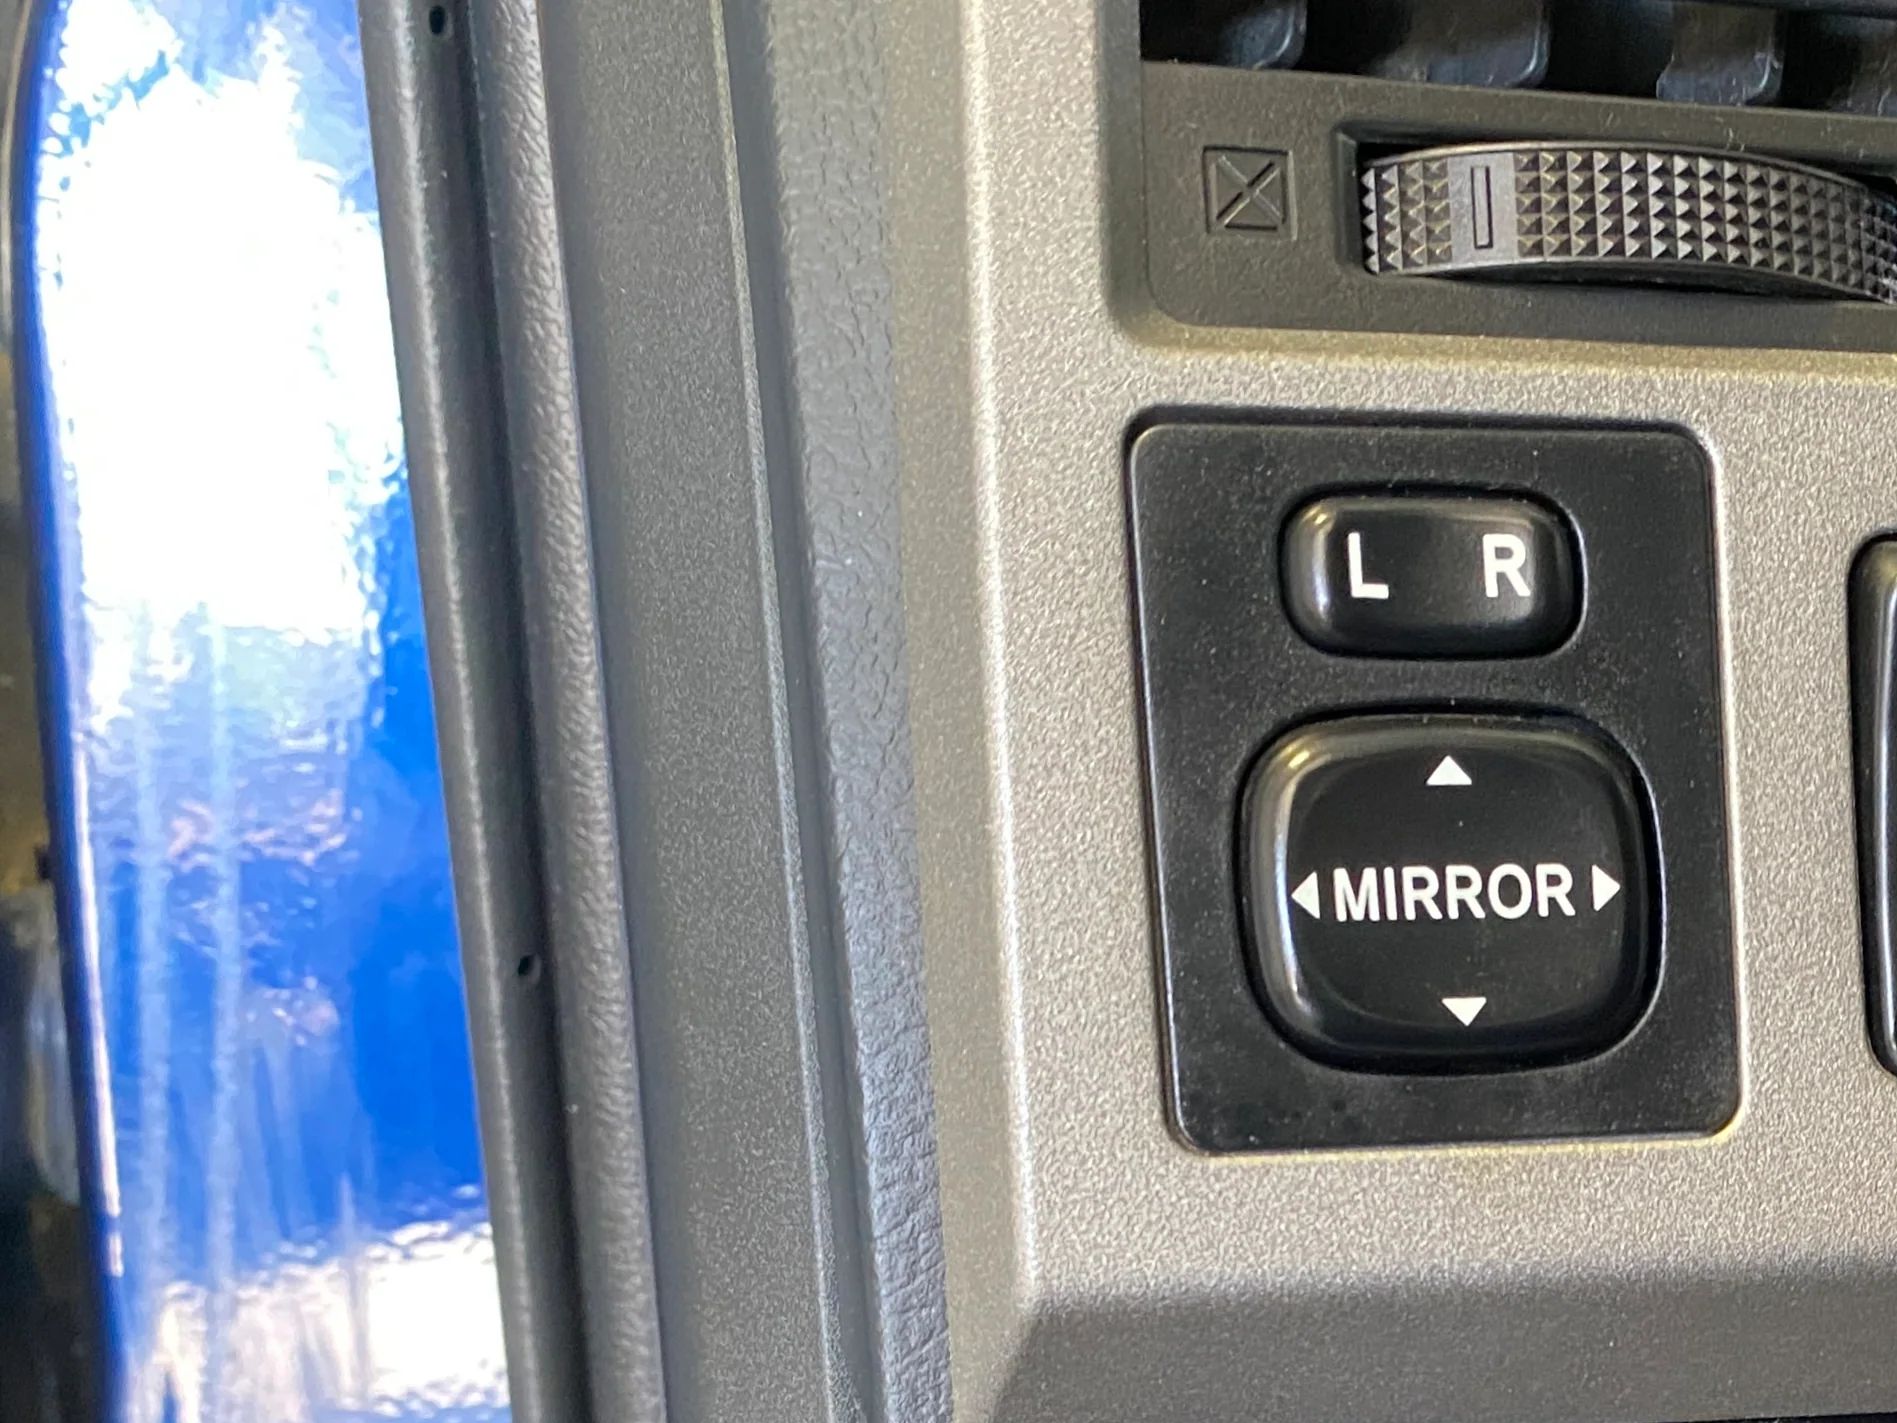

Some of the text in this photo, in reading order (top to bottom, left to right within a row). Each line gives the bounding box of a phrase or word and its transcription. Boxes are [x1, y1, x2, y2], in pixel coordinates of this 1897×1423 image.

[1347, 532, 1390, 600] L
[1482, 533, 1532, 598] R
[1333, 862, 1576, 922] MIRROR
